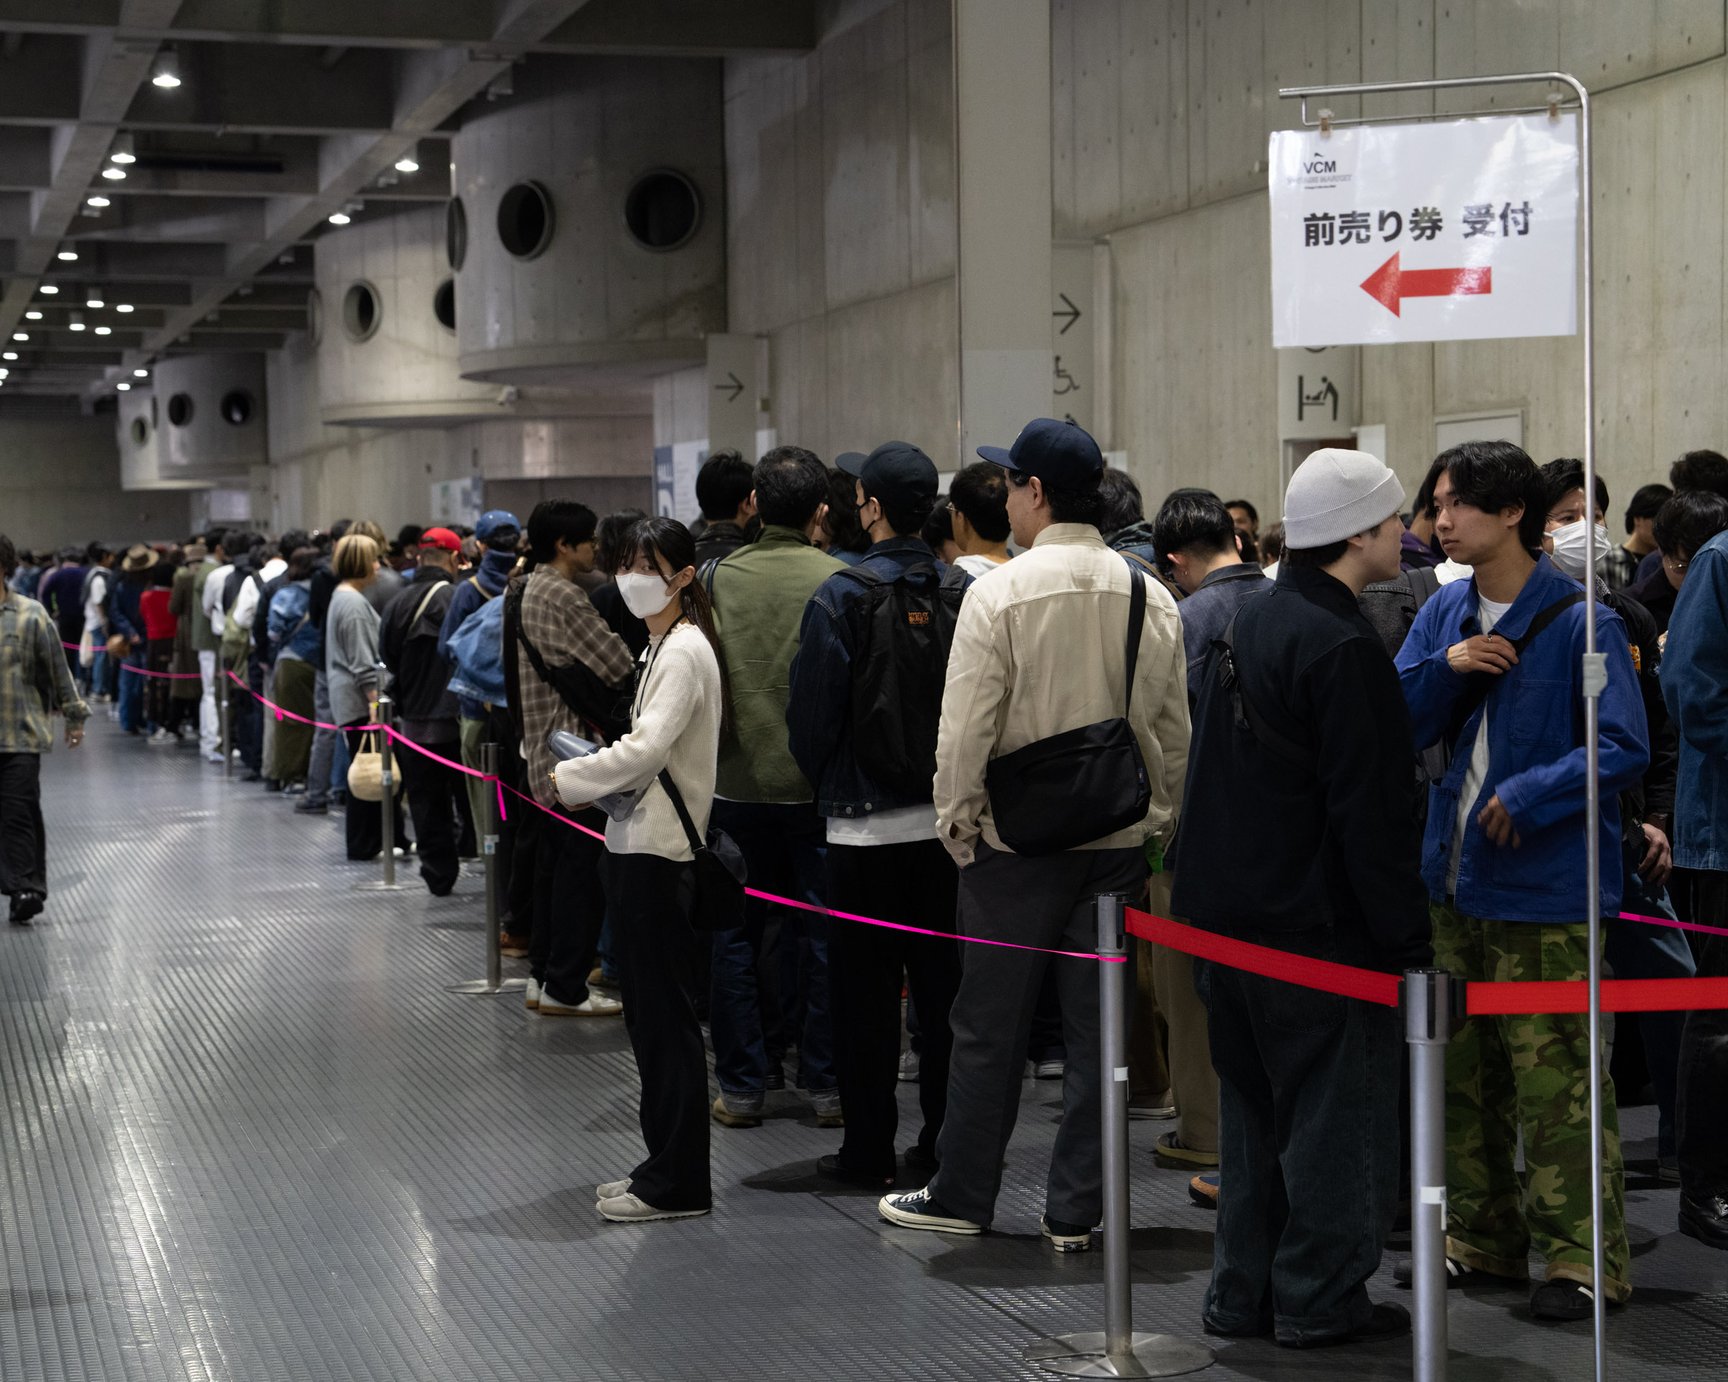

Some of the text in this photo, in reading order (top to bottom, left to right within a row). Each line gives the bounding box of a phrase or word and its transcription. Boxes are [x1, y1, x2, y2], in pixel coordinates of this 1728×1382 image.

[1303, 160, 1336, 174] VCM
[1303, 201, 1533, 247] 前売り券 受付
